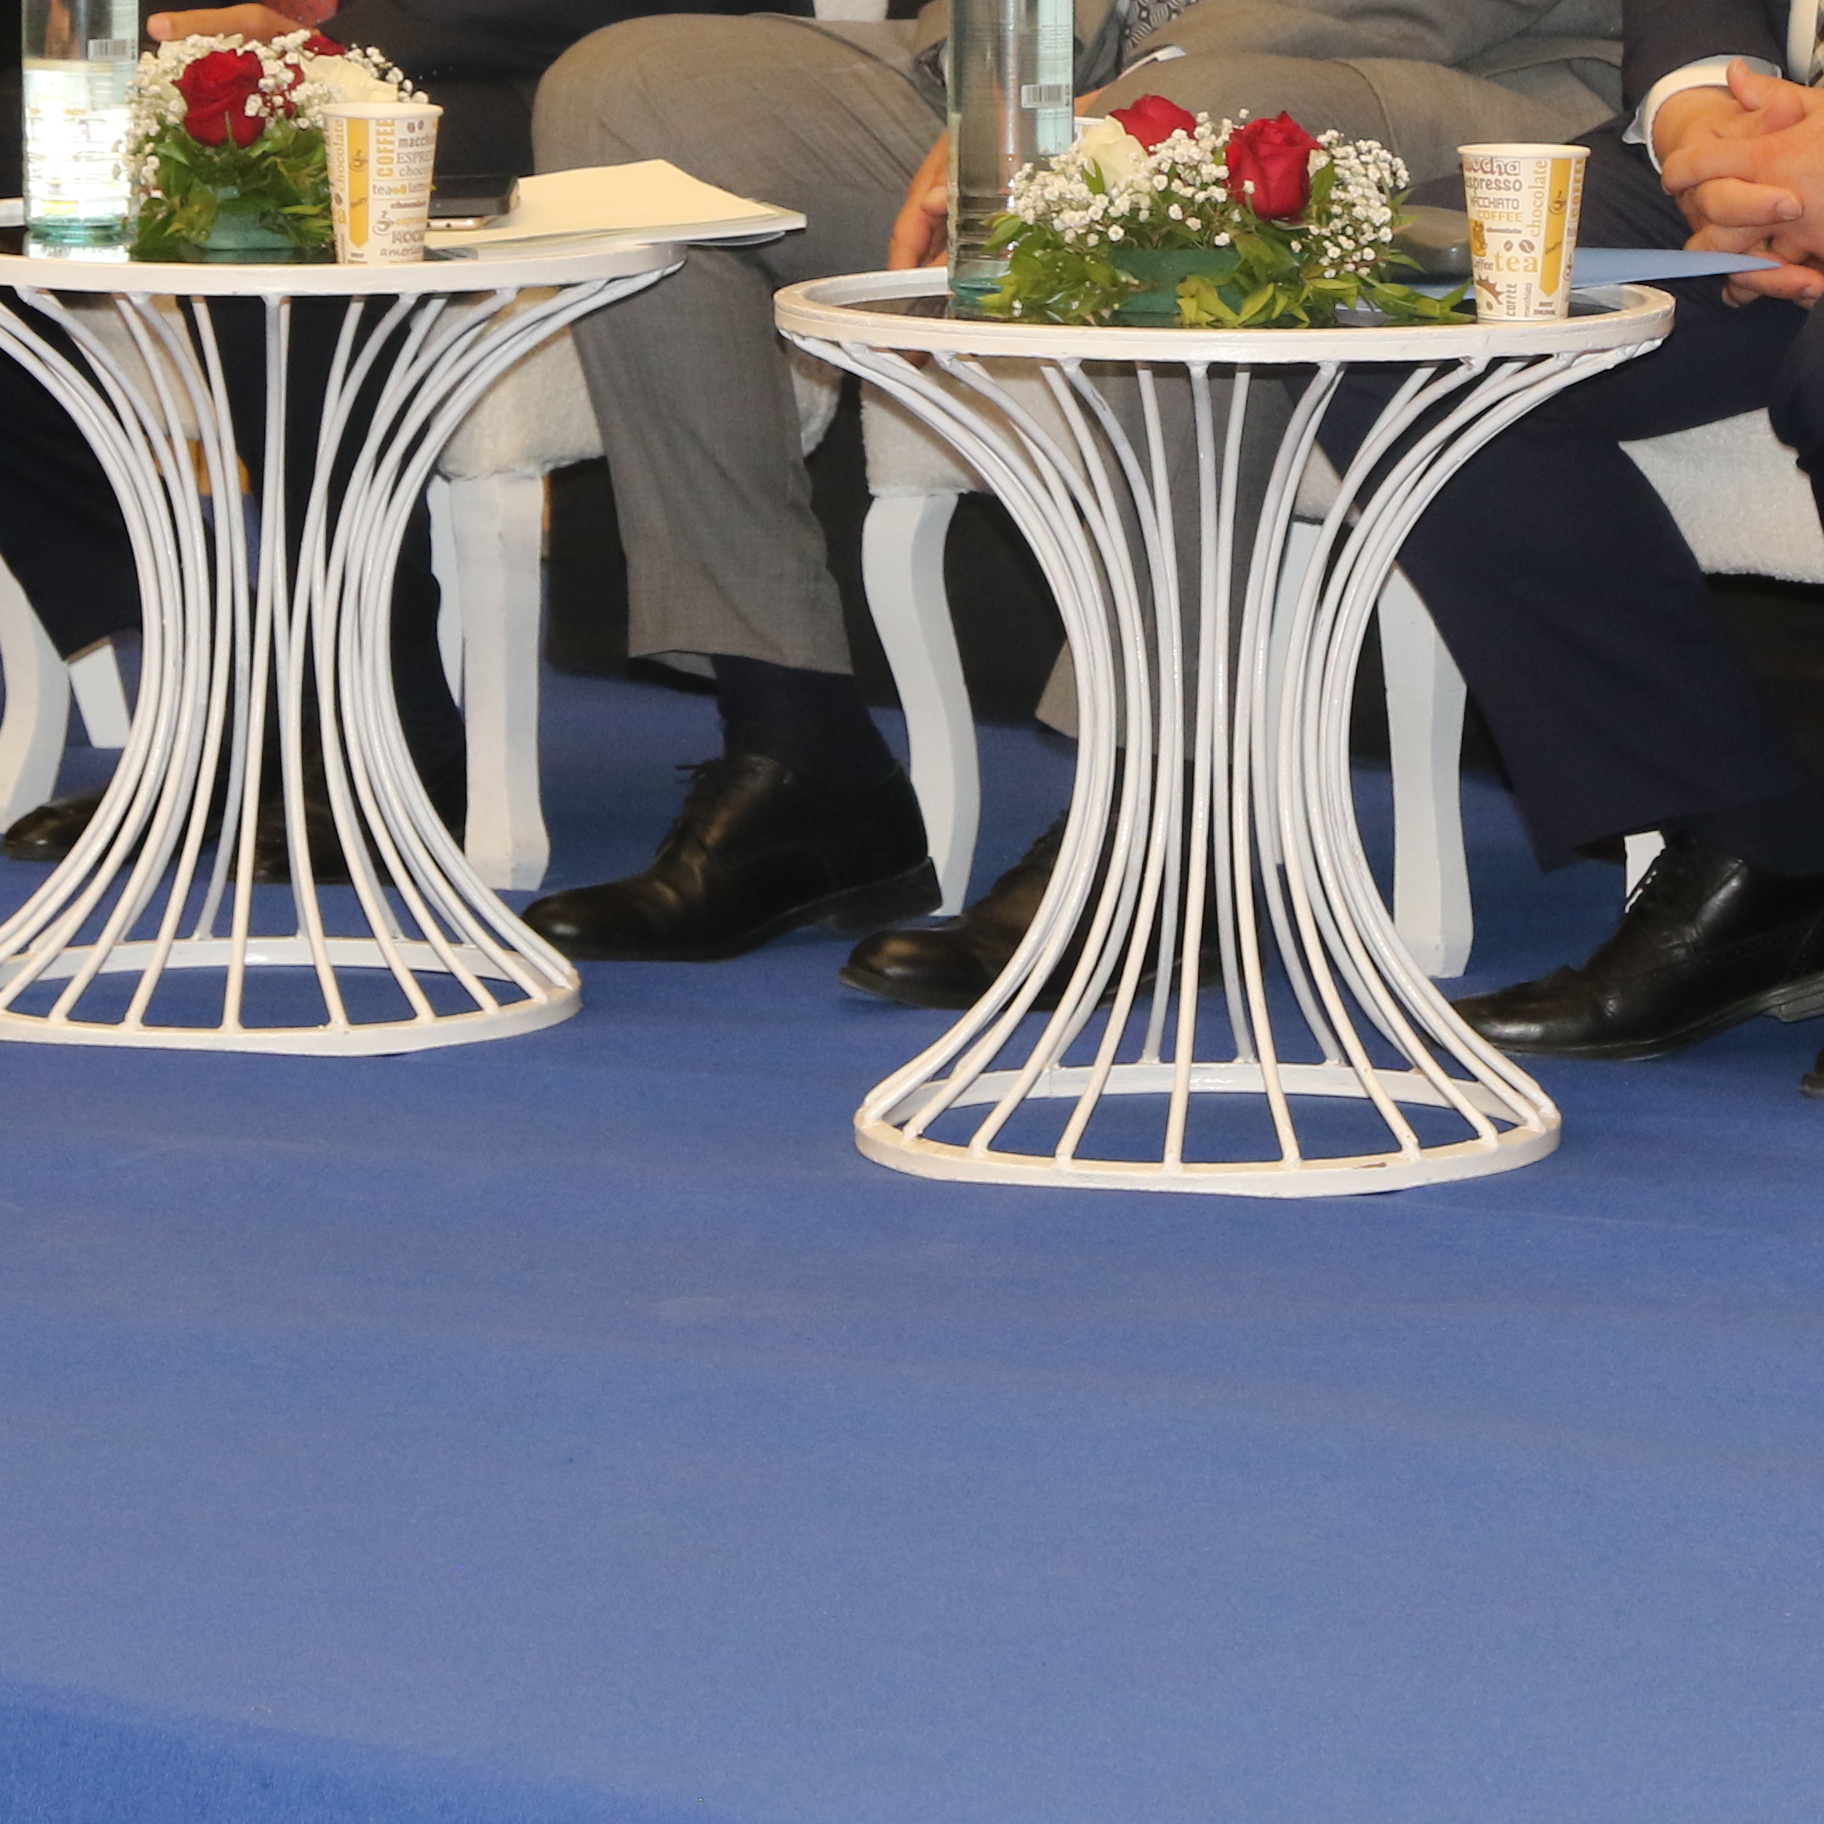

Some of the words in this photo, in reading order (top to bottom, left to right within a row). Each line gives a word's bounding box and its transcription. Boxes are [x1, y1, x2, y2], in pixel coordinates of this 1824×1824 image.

[376, 119, 395, 177] COFFEE
[1525, 159, 1548, 238] chocolate
[1494, 251, 1539, 273] tea
